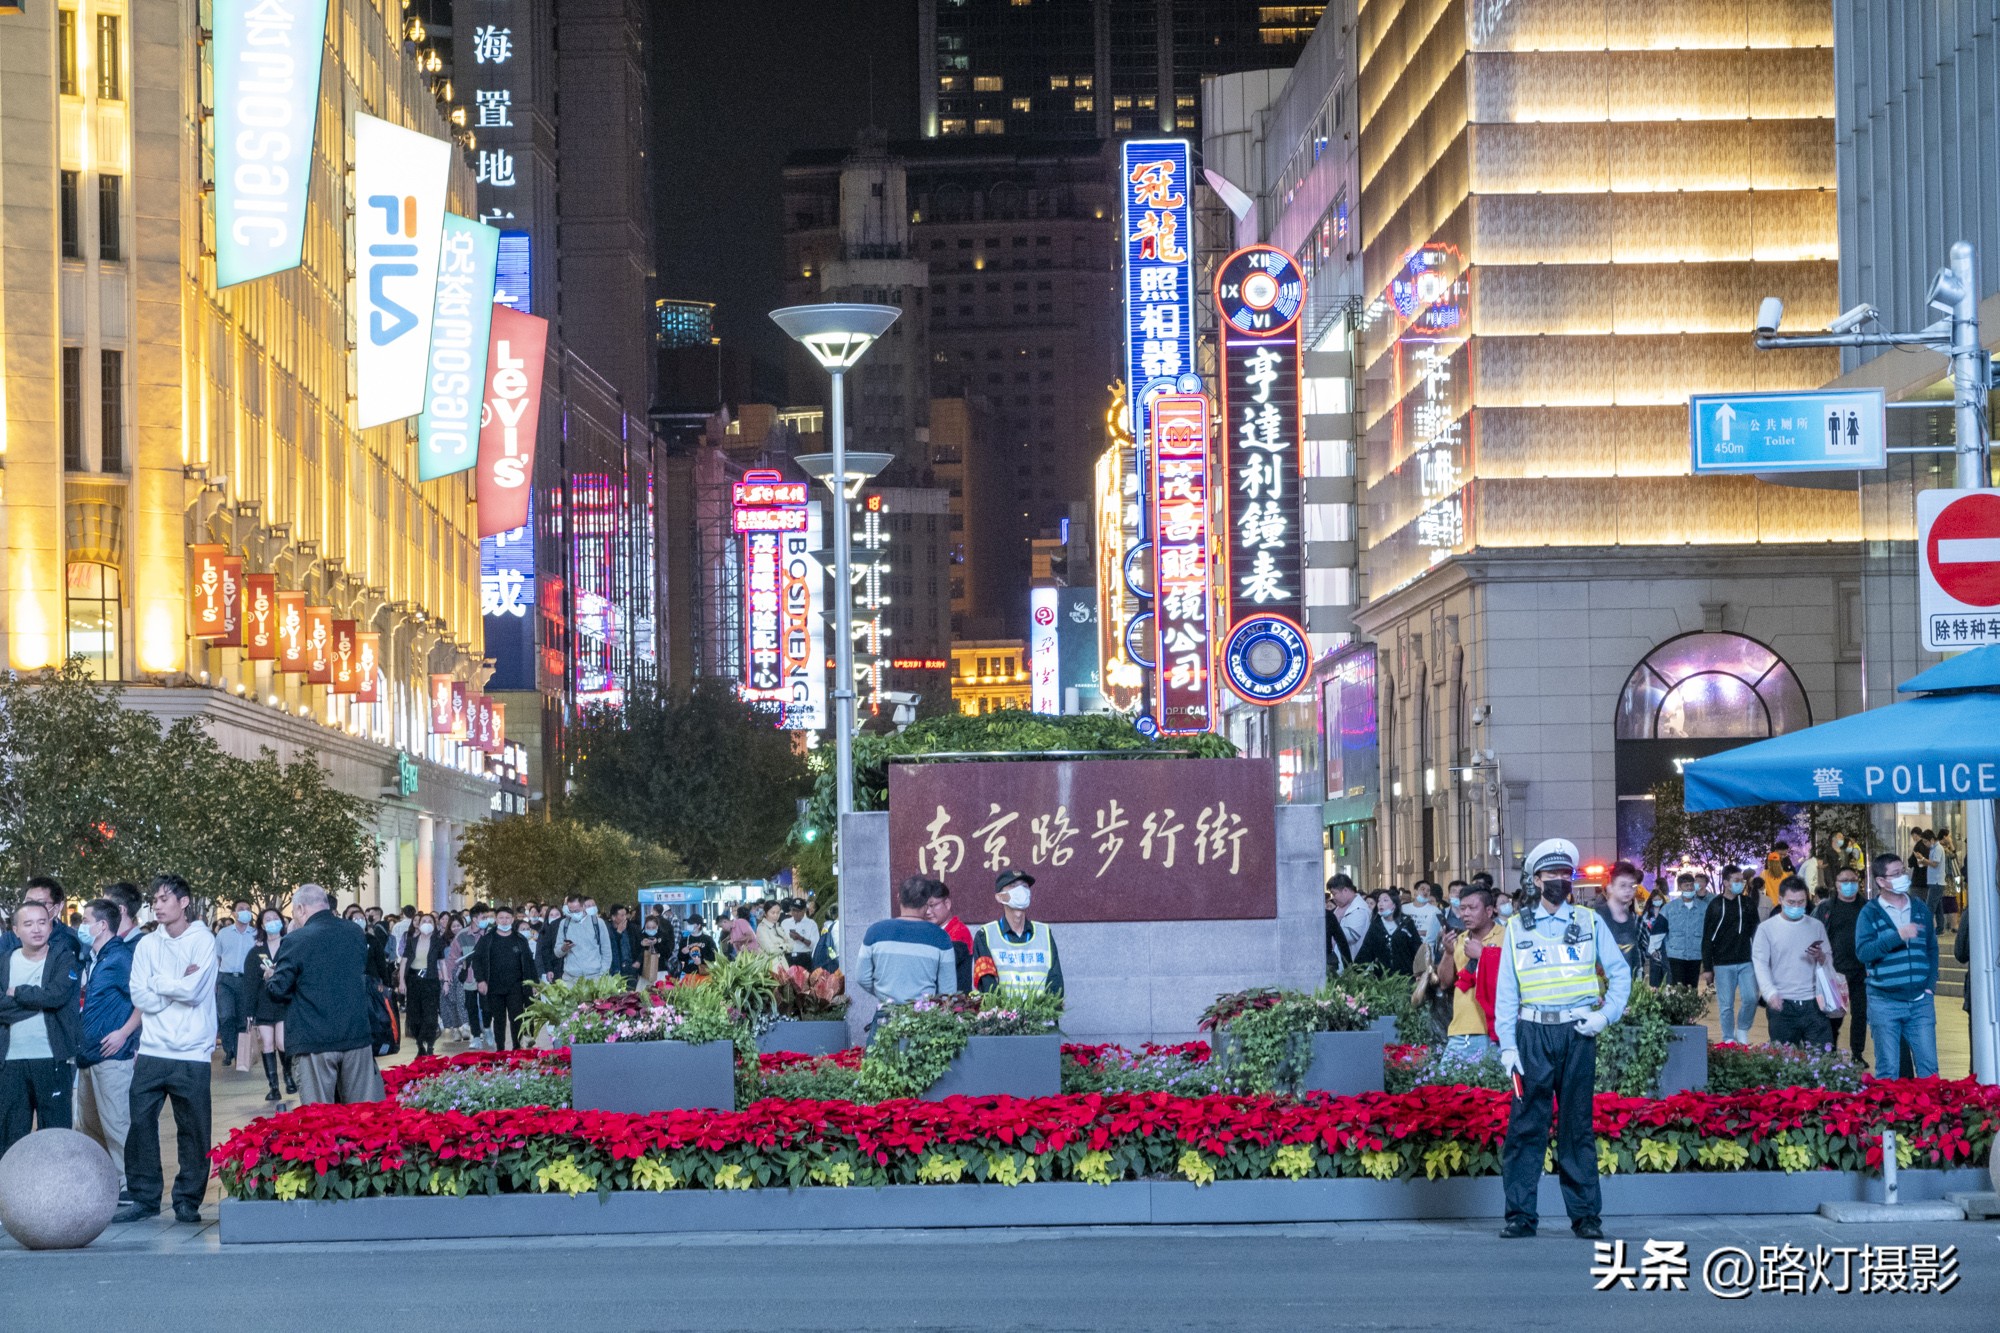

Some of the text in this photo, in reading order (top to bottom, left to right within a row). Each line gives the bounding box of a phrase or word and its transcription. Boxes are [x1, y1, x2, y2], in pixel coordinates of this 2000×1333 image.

[368, 195, 418, 346] FILA
[491, 340, 529, 488] Levi's
[1750, 417, 1809, 432] 公共厕所
[1714, 443, 1744, 454] 450m
[1764, 436, 1796, 446] Toilet
[202, 558, 219, 622] Levi's
[1161, 461, 1206, 692] 茂昌眼镜公司
[254, 588, 270, 646] Levi's
[286, 604, 300, 660] Levi's
[1234, 623, 1299, 650] HENG DALI
[312, 618, 327, 671] Levi's
[338, 631, 352, 682] Levi's
[1231, 654, 1302, 694] CLOCKS AND WATCHES
[1165, 705, 1208, 717] OPTICAL
[1812, 763, 1997, 798] 警 POLICE
[918, 799, 1249, 882] 南京路步行街
